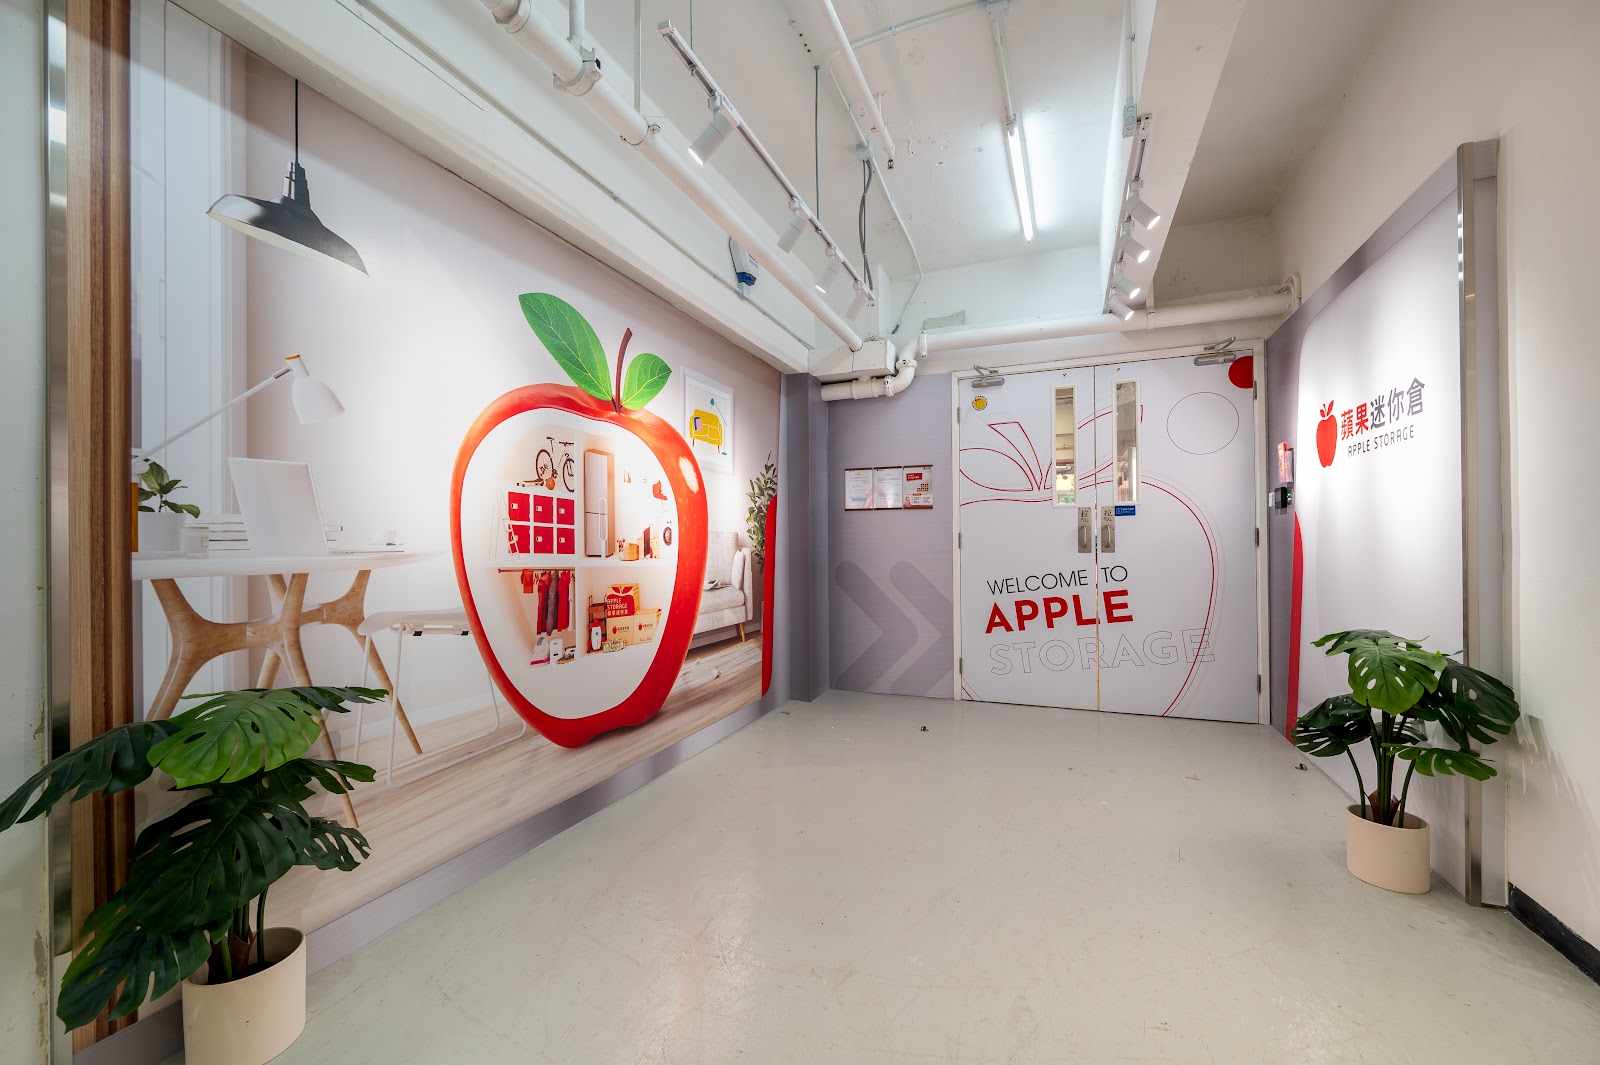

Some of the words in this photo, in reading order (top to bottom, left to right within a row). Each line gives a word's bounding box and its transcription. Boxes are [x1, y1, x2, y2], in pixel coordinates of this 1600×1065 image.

[1340, 377, 1425, 441] 蘋果迷你倉
[1347, 439, 1371, 458] APPLE
[1373, 424, 1415, 450] STORAGE
[986, 569, 1089, 596] WELCOME
[1100, 565, 1128, 583] TO
[985, 589, 1134, 634] APPLE
[989, 627, 1216, 676] STORAGE
